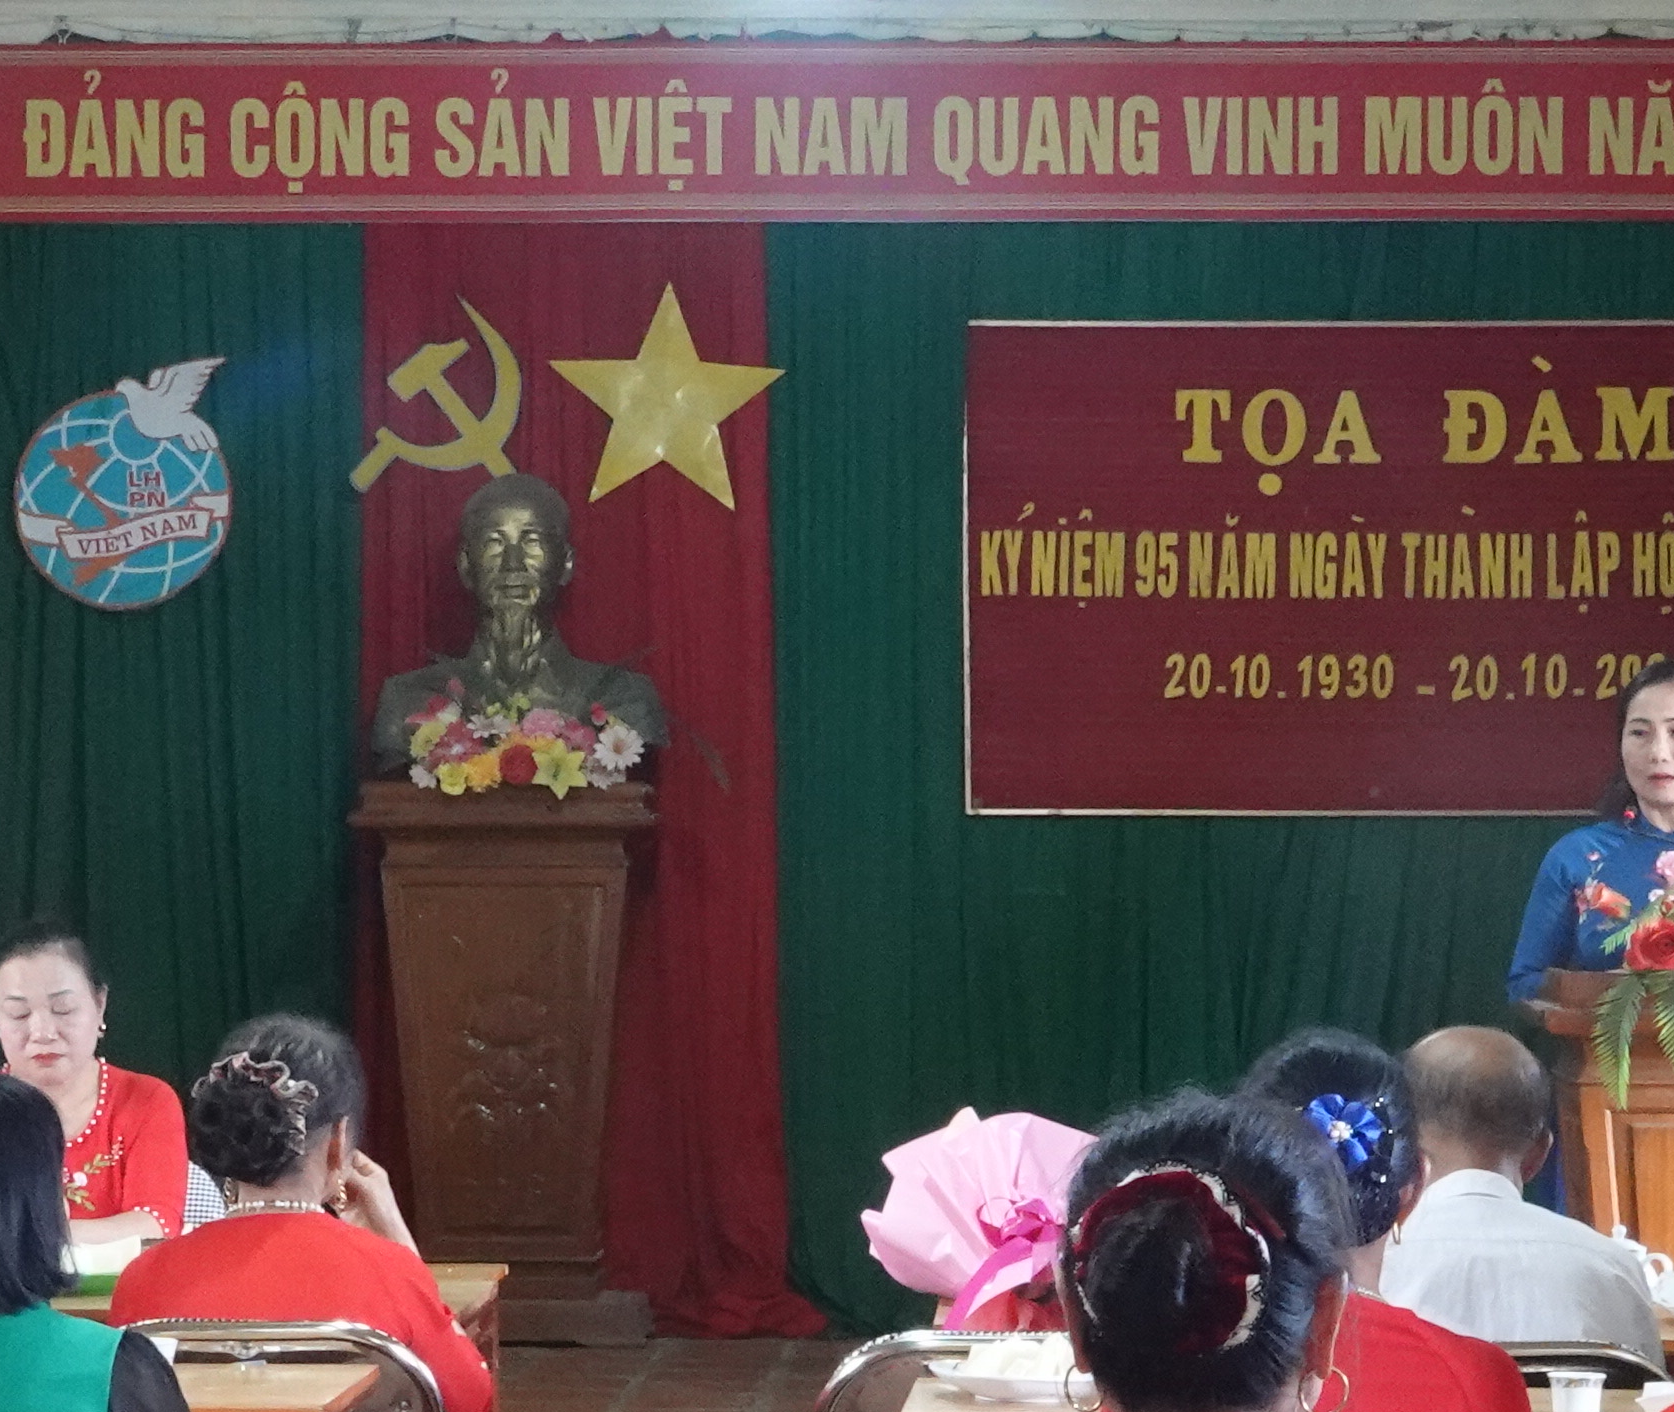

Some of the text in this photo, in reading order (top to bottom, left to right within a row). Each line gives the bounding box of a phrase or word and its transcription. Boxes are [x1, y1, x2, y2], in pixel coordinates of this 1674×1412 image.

[22, 69, 206, 179] ĐẢNG
[229, 80, 410, 194] CỘNG
[433, 68, 570, 178] SẢN
[592, 78, 733, 192] VIỆT
[754, 96, 909, 176] NAM
[932, 96, 1159, 185] QUANG
[1183, 96, 1338, 175] VINH
[1364, 78, 1565, 176] MUÔN
[1174, 388, 1382, 497] TỌA
[128, 470, 161, 487] LH
[128, 491, 166, 507] PN
[140, 514, 198, 542] NAM
[1030, 507, 1127, 609] NIỆM
[1134, 530, 1180, 599] 95
[1188, 511, 1278, 599] NĂM
[1289, 513, 1388, 600] NGÀY
[1400, 504, 1534, 600] THÀNH
[1546, 509, 1622, 614] LẬP
